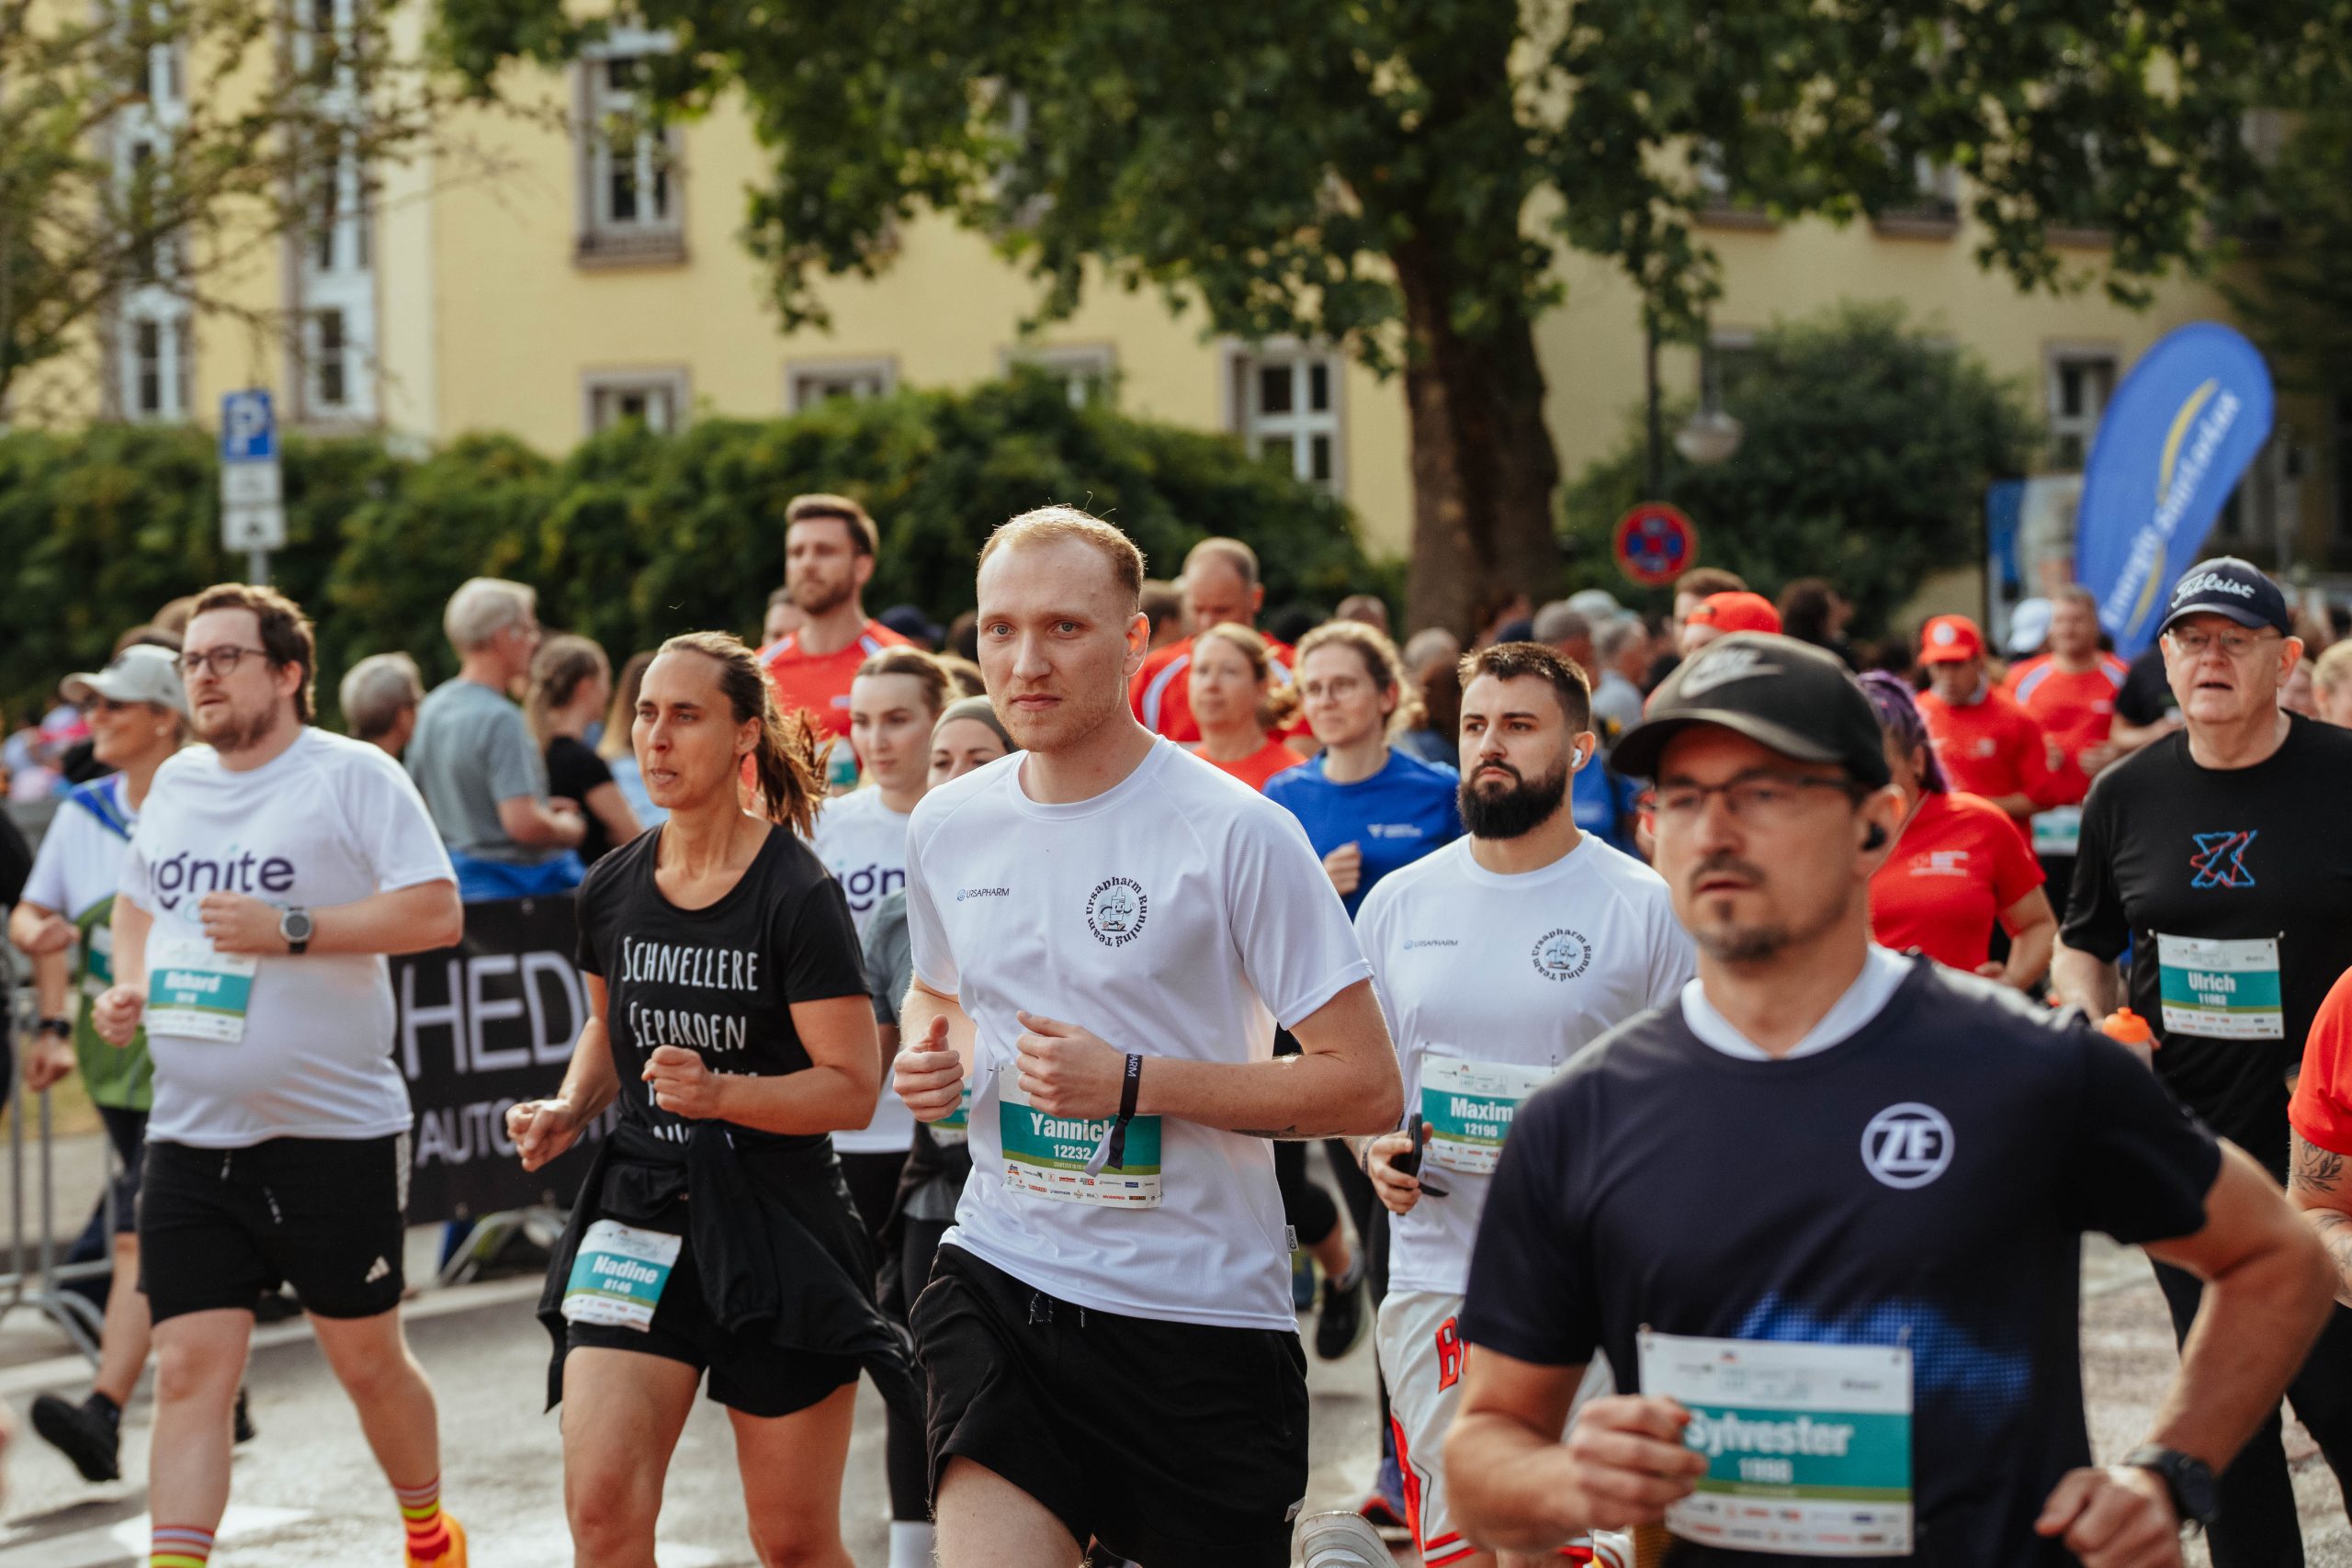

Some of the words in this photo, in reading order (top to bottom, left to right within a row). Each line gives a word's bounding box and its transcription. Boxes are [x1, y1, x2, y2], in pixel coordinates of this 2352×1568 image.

[232, 398, 267, 454] P
[150, 844, 296, 909] ignite
[967, 887, 1010, 898] URSAPHARM
[1086, 876, 1142, 915] Ursapharm
[1088, 917, 1113, 947] Team
[1115, 895, 1148, 947] Running
[1532, 958, 1556, 980] Team
[2188, 971, 2236, 993] Ulrich
[1451, 1097, 1514, 1122] Maxim
[1464, 1122, 1498, 1137] 12196
[1053, 1144, 1091, 1160] 12232
[1869, 1115, 1947, 1175] ZF
[592, 1254, 659, 1284] Nadine
[1684, 1408, 1855, 1458] Sylvester
